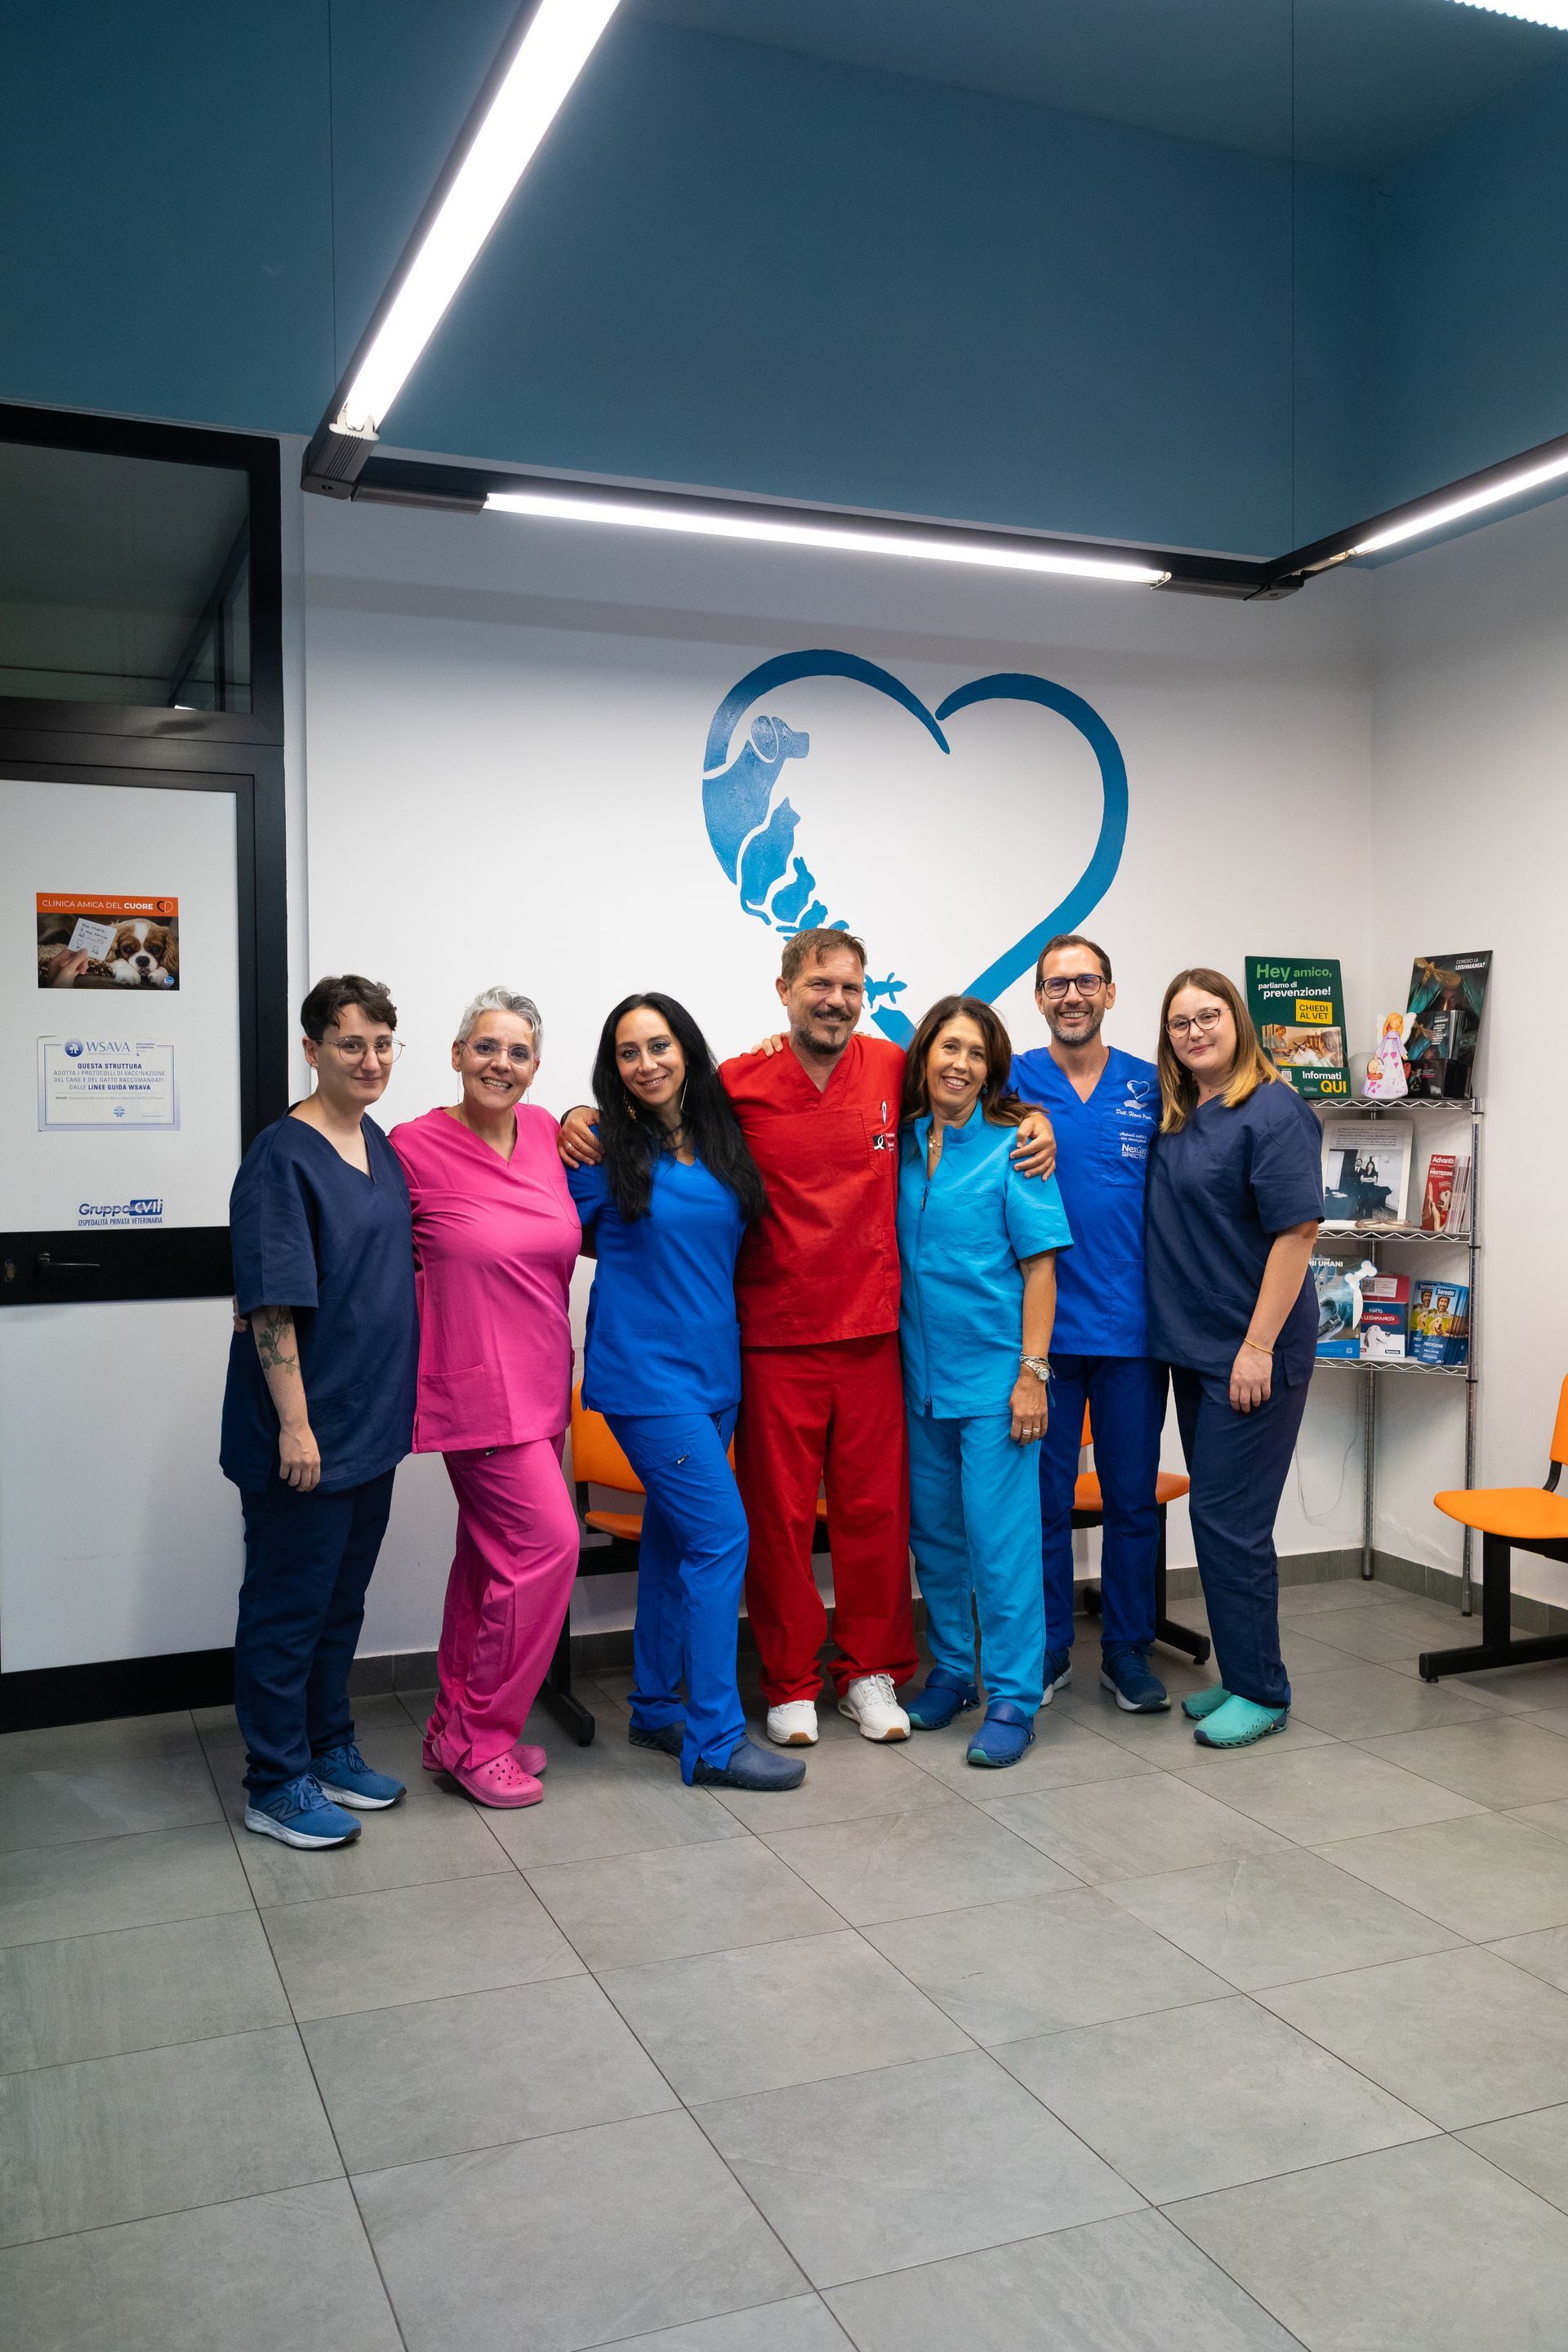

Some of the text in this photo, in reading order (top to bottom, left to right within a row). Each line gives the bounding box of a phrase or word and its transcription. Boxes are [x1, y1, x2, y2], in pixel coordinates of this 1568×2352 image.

[1256, 964, 1332, 981] Hey amico,
[1258, 982, 1290, 991] parliamo
[1263, 986, 1331, 1000] prevenzione!
[86, 1041, 131, 1053] WSAVA
[1302, 1071, 1342, 1080] Informati
[1320, 1080, 1347, 1094] QUI
[78, 1203, 131, 1217] Gruppo
[78, 1217, 109, 1226] OSPEDALITÀ
